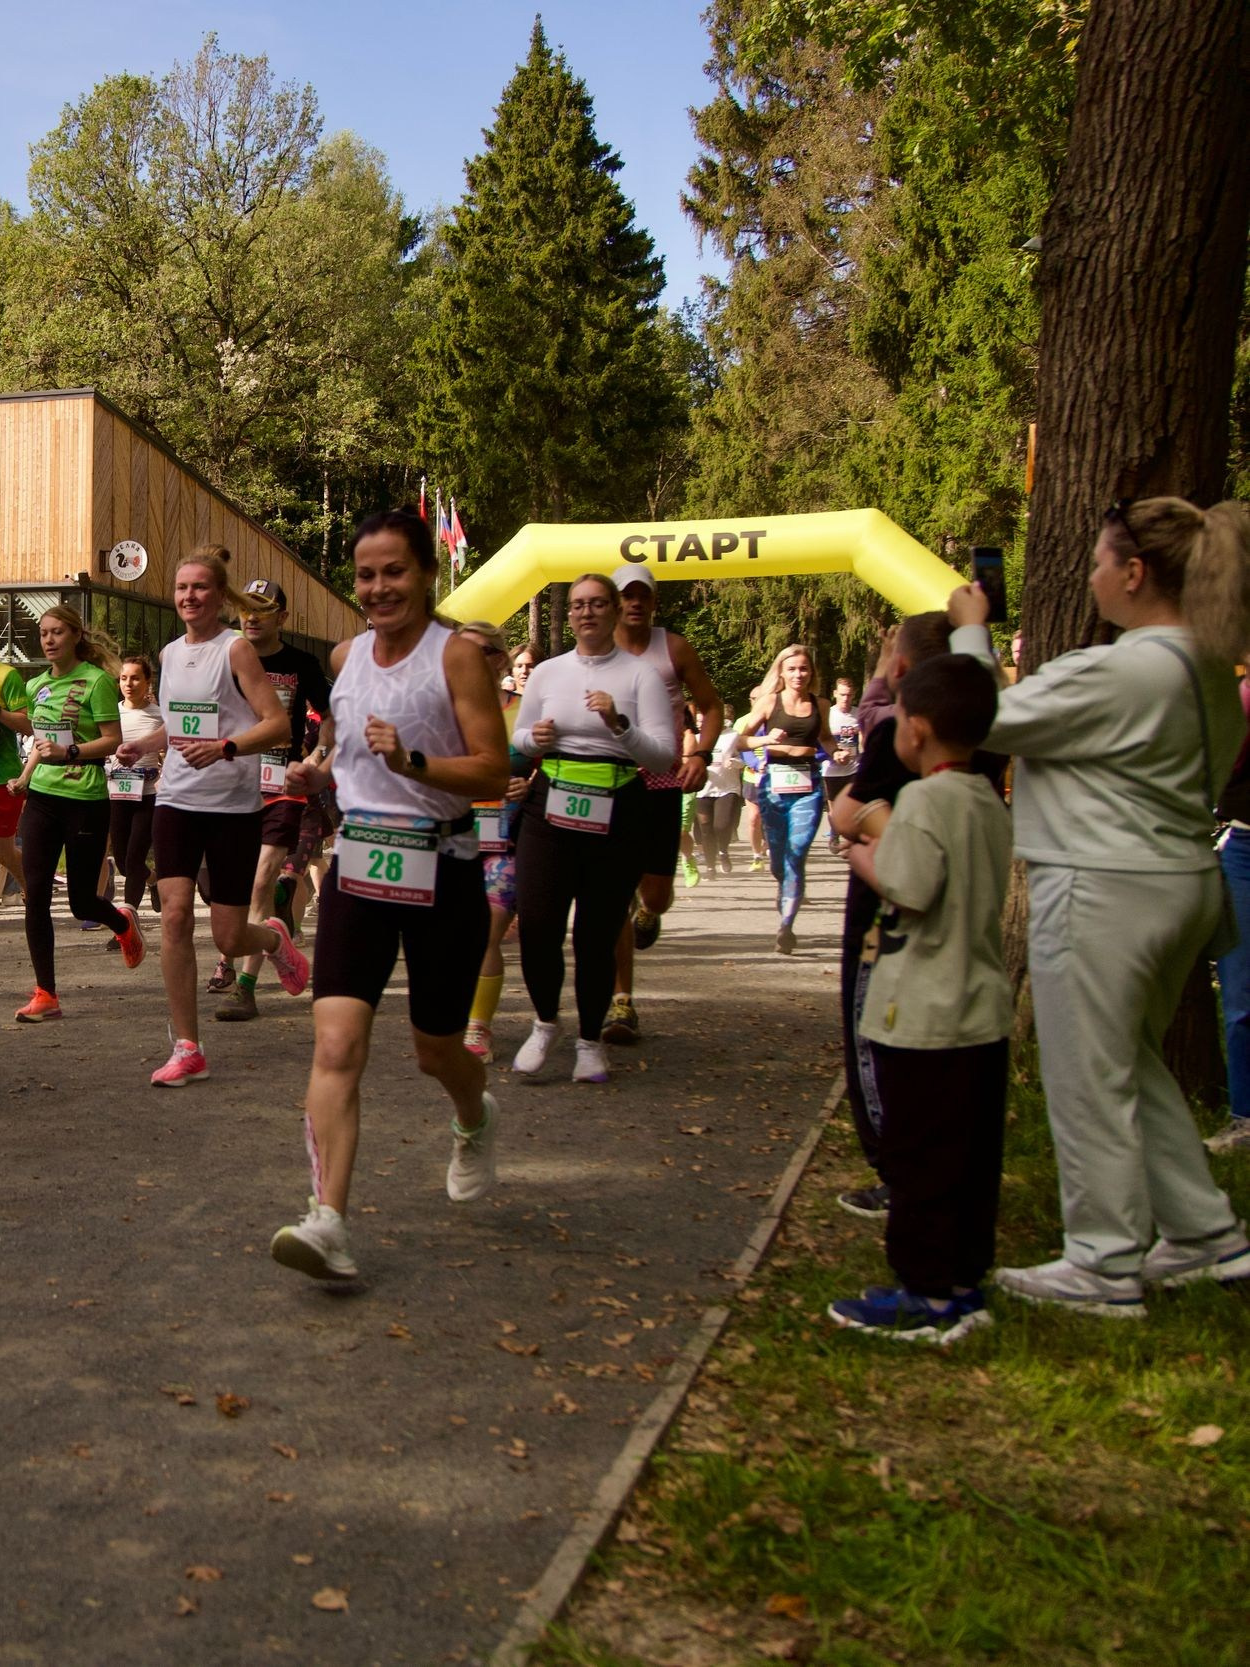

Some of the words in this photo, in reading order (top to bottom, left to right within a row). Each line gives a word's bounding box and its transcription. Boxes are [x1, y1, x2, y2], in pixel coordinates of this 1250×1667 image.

[620, 530, 767, 563] СТАРТ
[183, 715, 201, 735] 62
[118, 781, 131, 792] 35
[785, 774, 799, 785] 42
[566, 795, 592, 818] 30
[367, 848, 403, 882] 28
